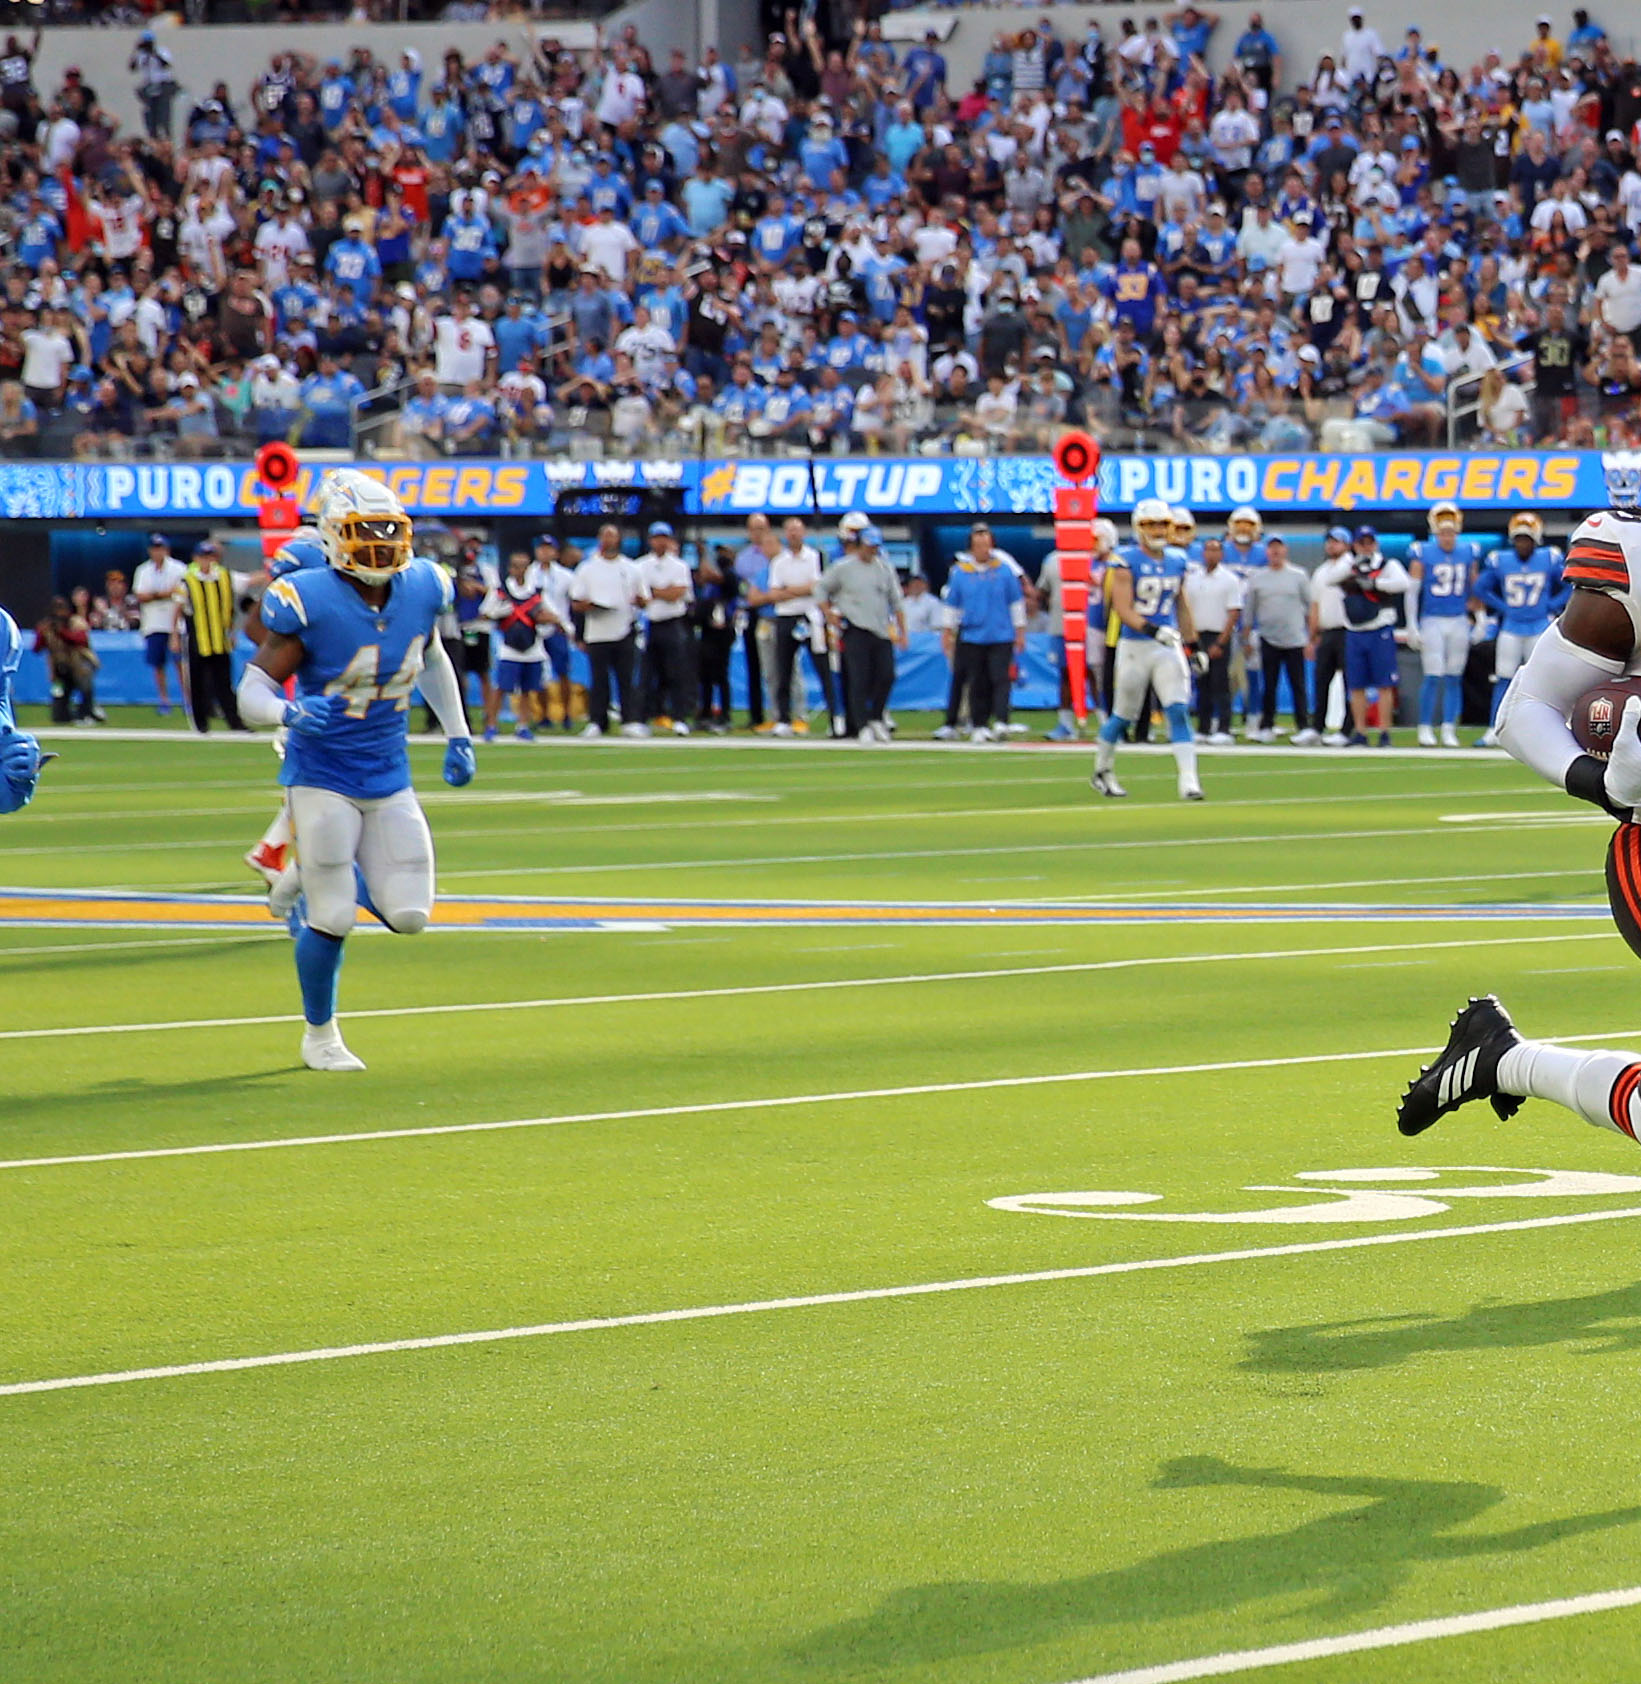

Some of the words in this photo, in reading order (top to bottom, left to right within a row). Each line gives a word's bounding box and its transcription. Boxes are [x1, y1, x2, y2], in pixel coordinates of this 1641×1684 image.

[107, 466, 236, 509] PURO
[702, 462, 942, 508] #BOLTUP
[1119, 458, 1257, 502] PURO
[1262, 459, 1578, 508] CHARGERS
[1134, 575, 1175, 617] 97
[1431, 561, 1467, 598] 31
[1505, 572, 1546, 608] 57
[323, 634, 426, 720] 44
